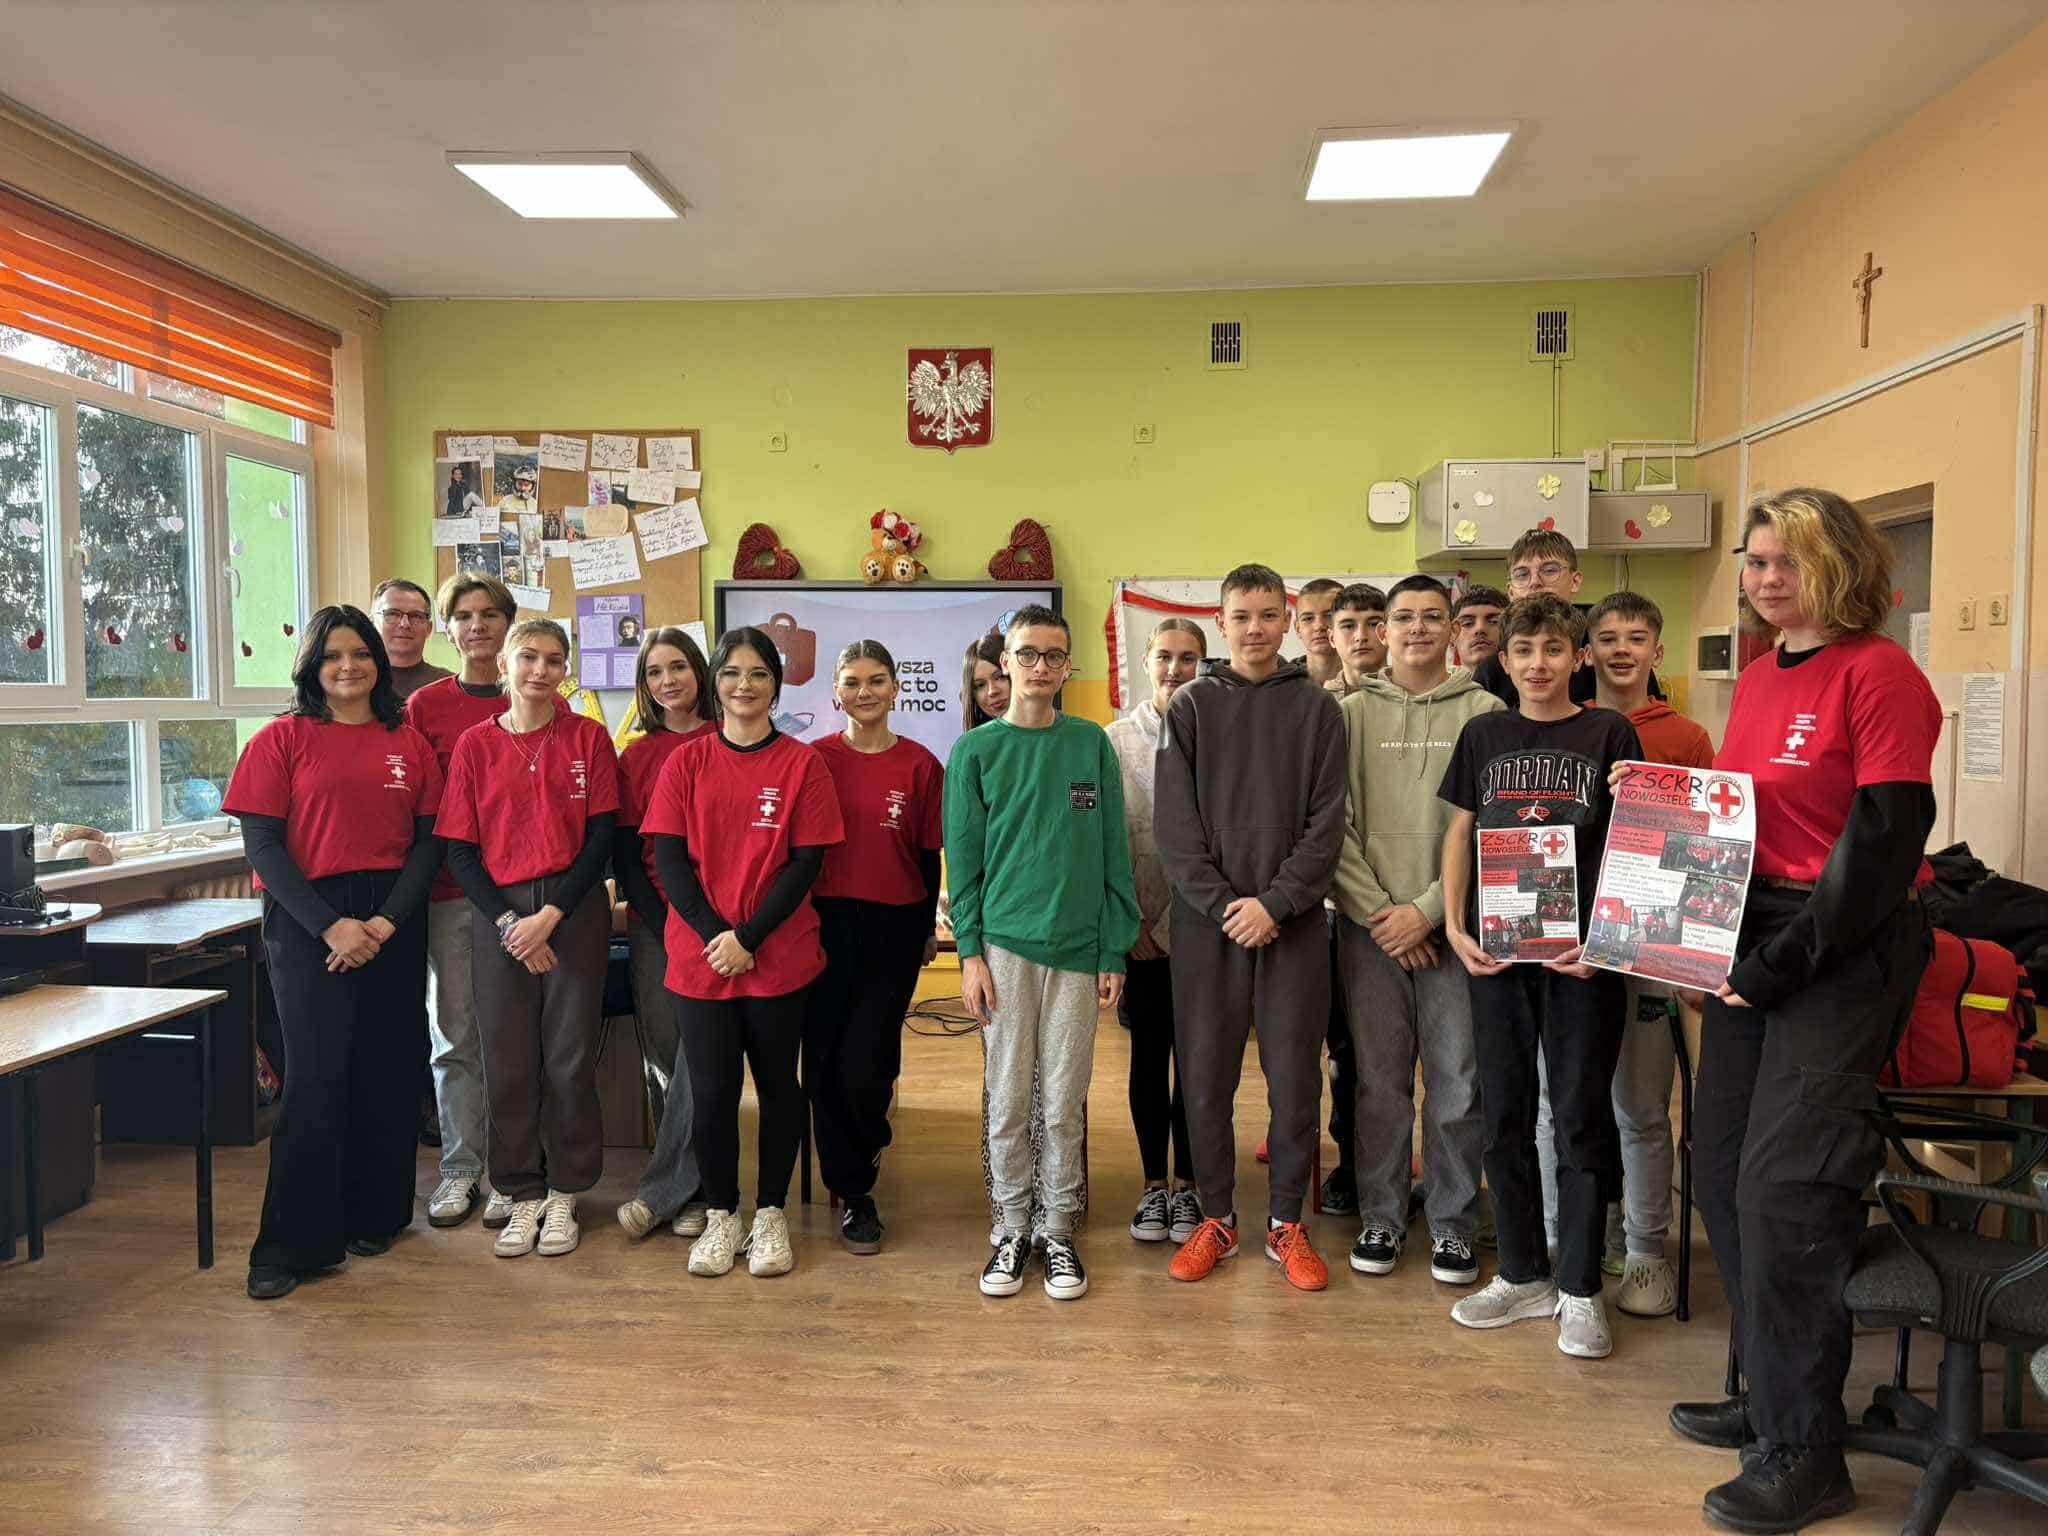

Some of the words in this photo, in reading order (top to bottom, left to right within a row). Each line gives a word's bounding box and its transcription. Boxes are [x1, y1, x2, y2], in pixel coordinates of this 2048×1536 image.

[917, 677, 938, 693] to
[901, 699, 946, 712] moc
[1482, 754, 1598, 808] JORDAN
[1621, 769, 1703, 794] ZSCKR
[1619, 789, 1698, 808] NOWOSIELCE
[1481, 832, 1538, 846] ZSCKR
